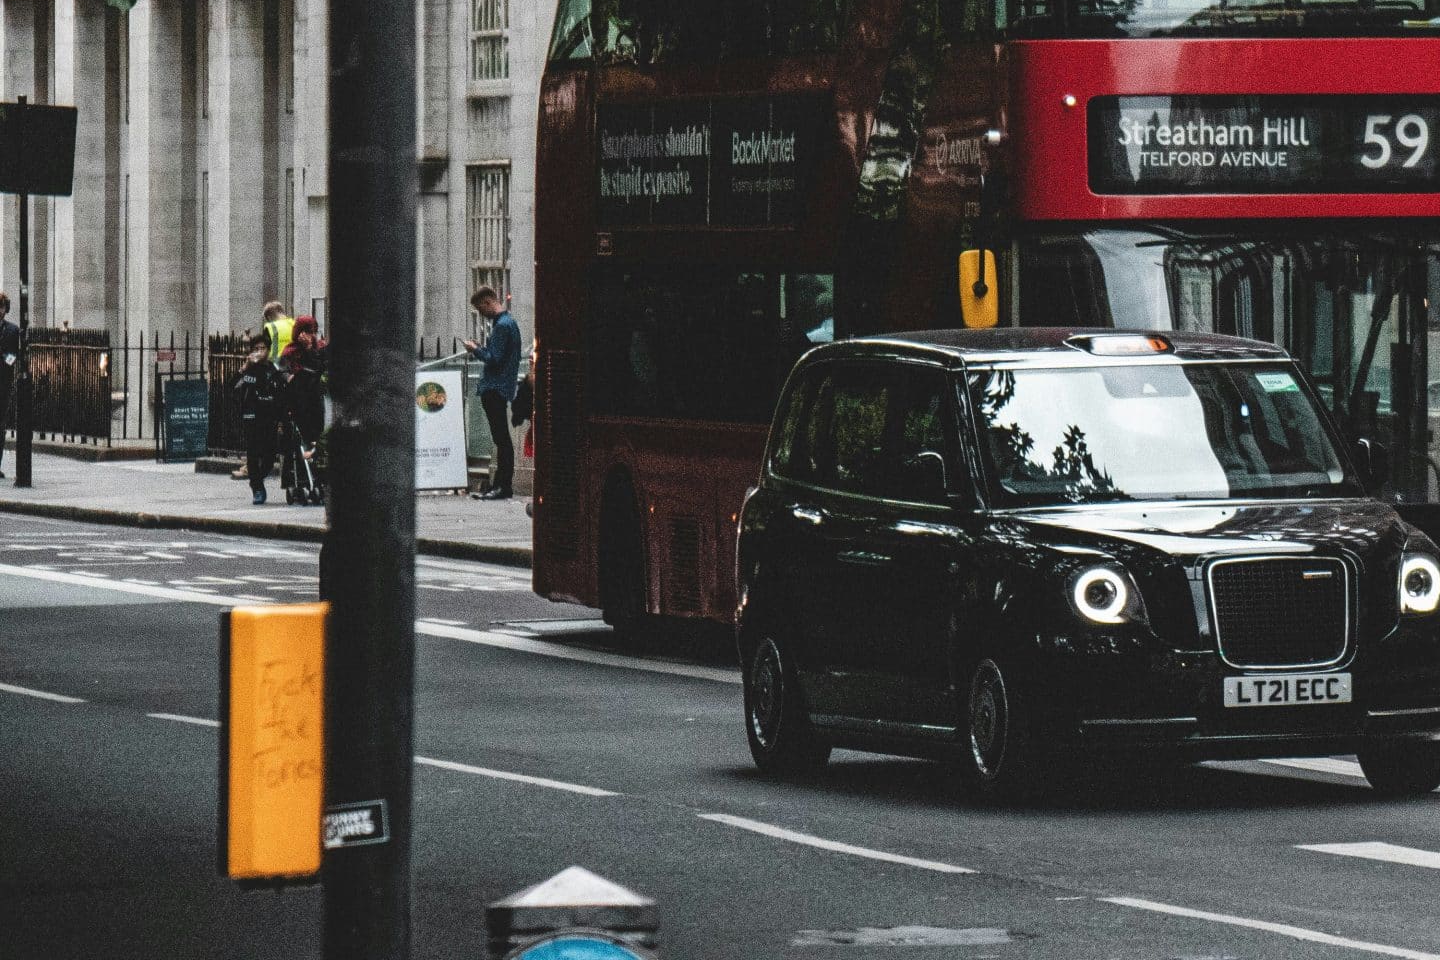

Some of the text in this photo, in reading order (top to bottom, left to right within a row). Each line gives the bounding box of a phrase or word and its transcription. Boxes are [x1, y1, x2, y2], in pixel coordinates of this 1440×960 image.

[1118, 116, 1310, 146] Streatham Hill
[1360, 114, 1430, 169] 59
[1141, 151, 1288, 167] TELFORD AVENUE
[1237, 678, 1339, 703] LT21 ECC
